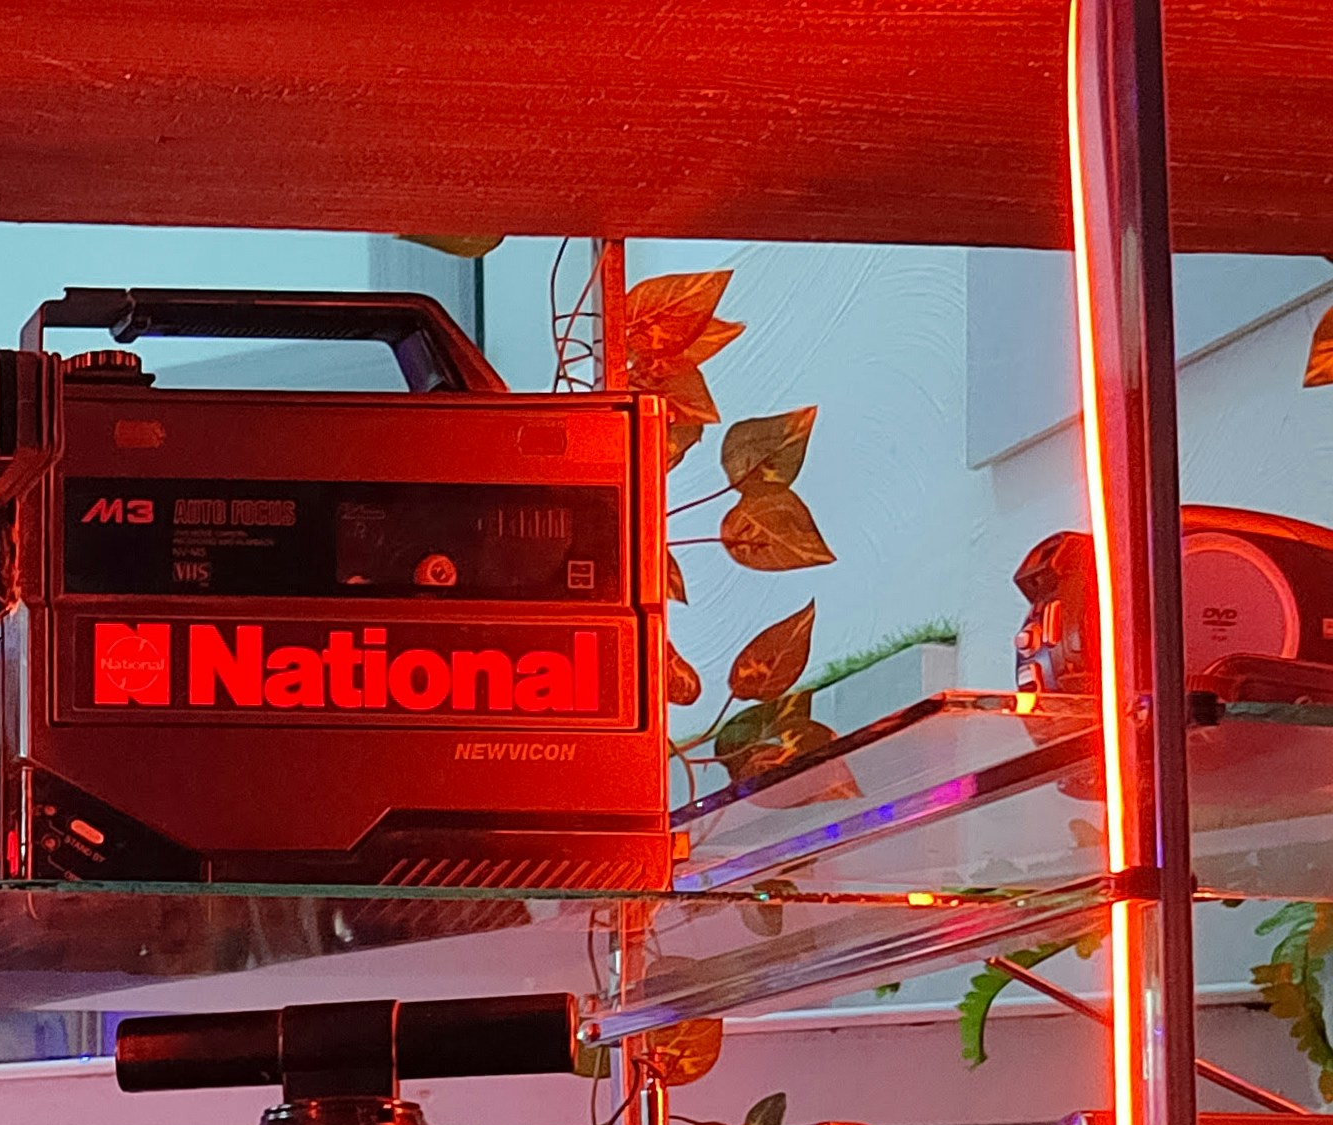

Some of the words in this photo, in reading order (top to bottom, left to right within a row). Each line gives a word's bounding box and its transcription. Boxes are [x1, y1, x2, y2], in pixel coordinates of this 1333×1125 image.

[81, 498, 154, 524] M3
[173, 499, 227, 525] AUTO
[230, 499, 297, 526] FOCUS
[1202, 607, 1238, 620] DVD
[188, 624, 601, 713] National
[454, 742, 576, 761] NEWVICON
